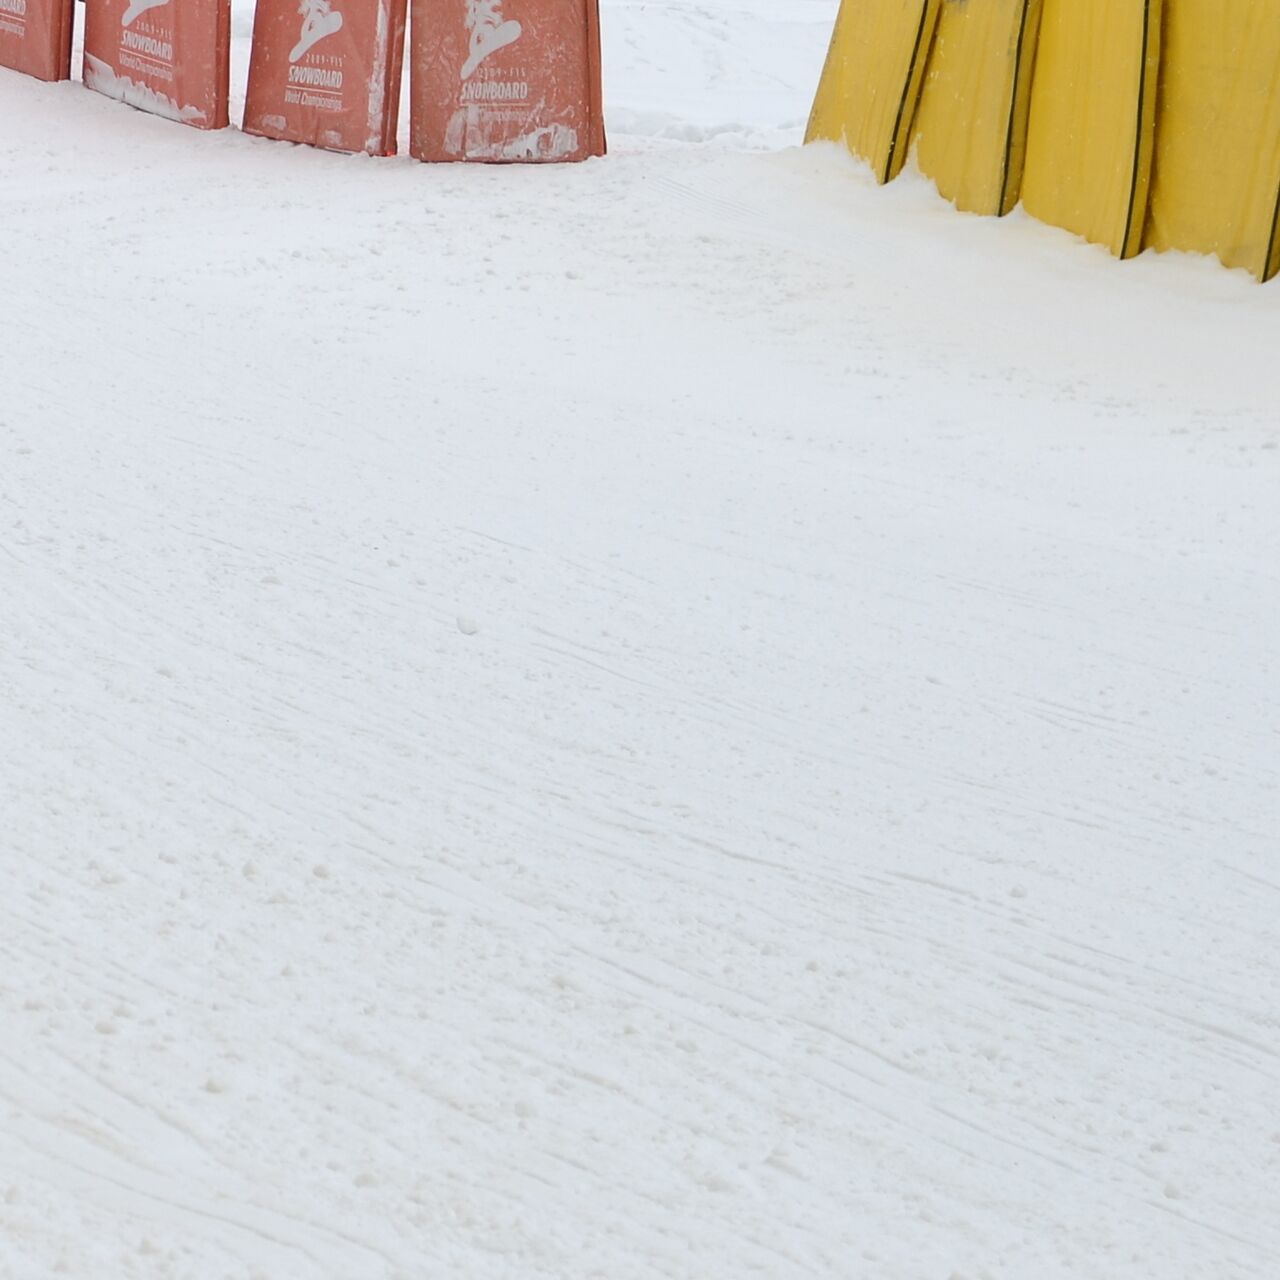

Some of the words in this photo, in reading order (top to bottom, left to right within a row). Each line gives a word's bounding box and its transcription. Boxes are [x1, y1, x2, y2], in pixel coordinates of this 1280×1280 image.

[121, 29, 173, 61] SNOWBOARD
[288, 65, 343, 89] SNOWBOARD
[460, 81, 528, 102] SNOWBOARD
